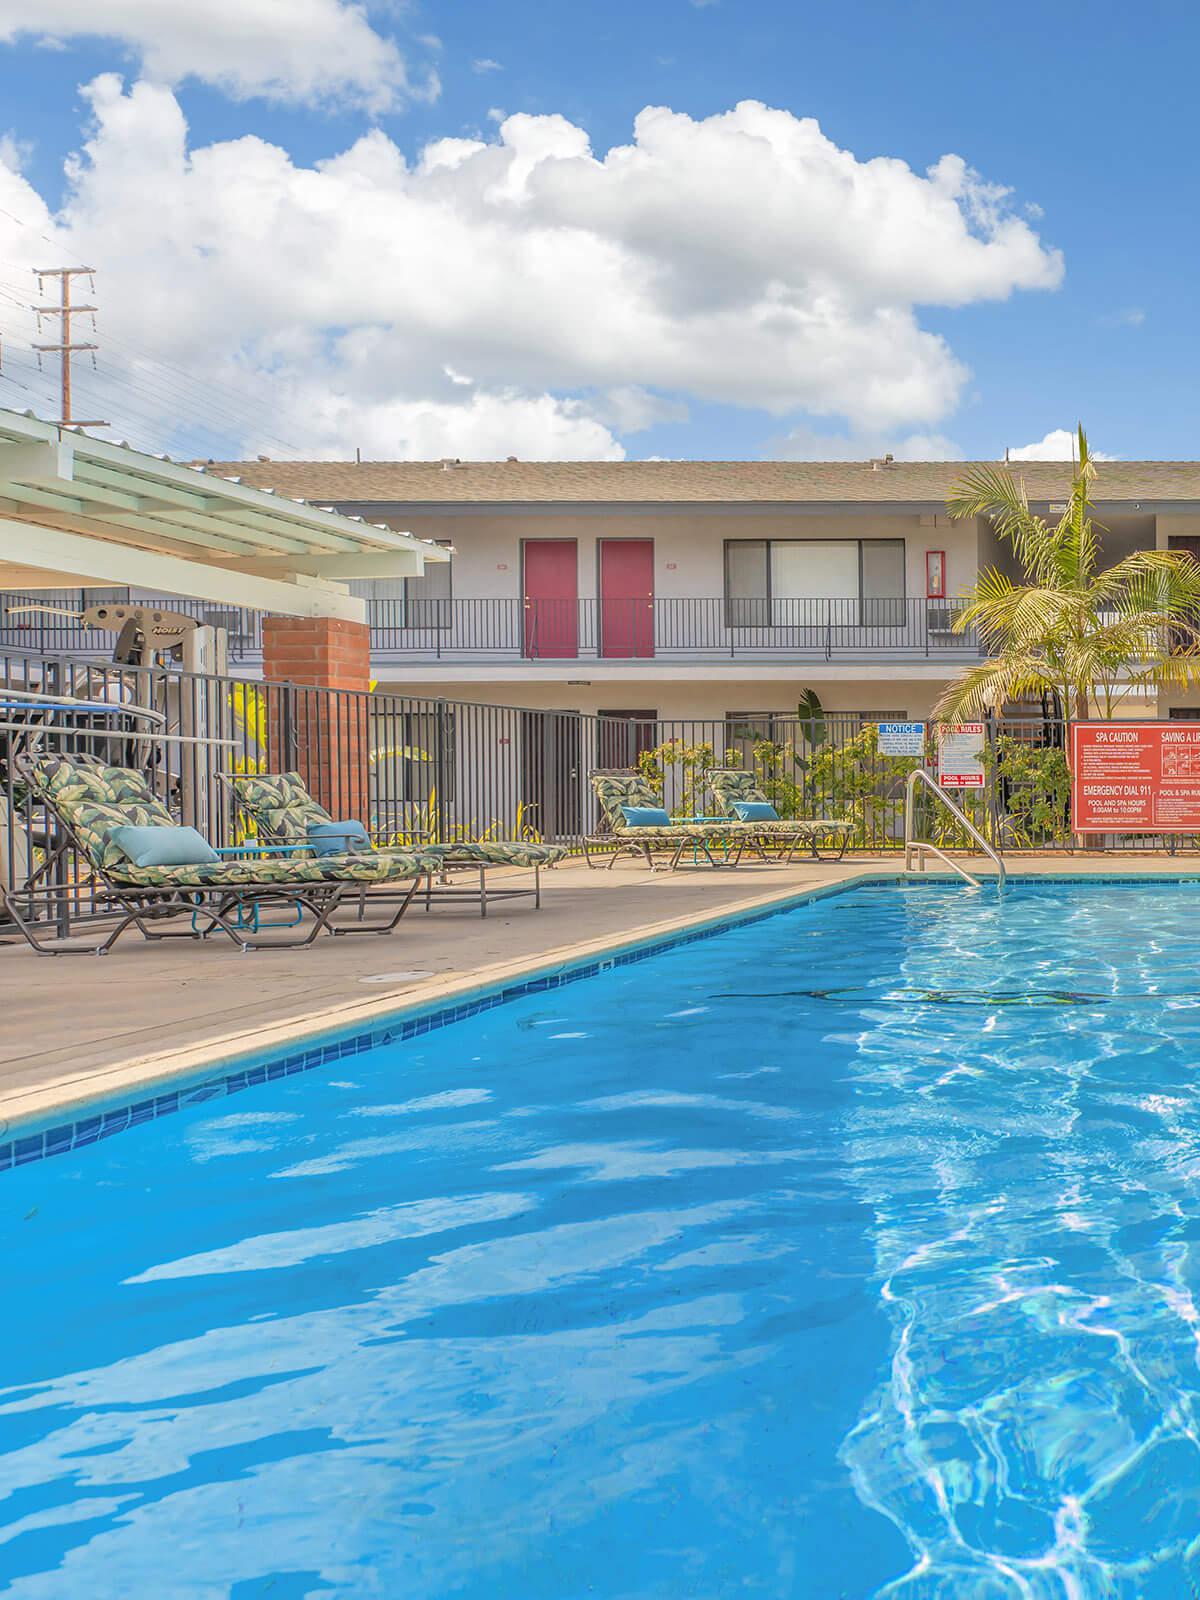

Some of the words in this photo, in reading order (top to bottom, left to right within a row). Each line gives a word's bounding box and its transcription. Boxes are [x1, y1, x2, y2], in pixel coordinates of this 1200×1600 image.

[886, 725, 916, 733] NOTICE
[1096, 732, 1108, 742] SPA
[1109, 732, 1138, 742] CAUTION
[1161, 732, 1185, 742] SAVING
[1186, 732, 1191, 742] A
[1084, 786, 1123, 796] EMERGENCY
[1124, 786, 1139, 796] DIAL
[1140, 786, 1151, 796] 911
